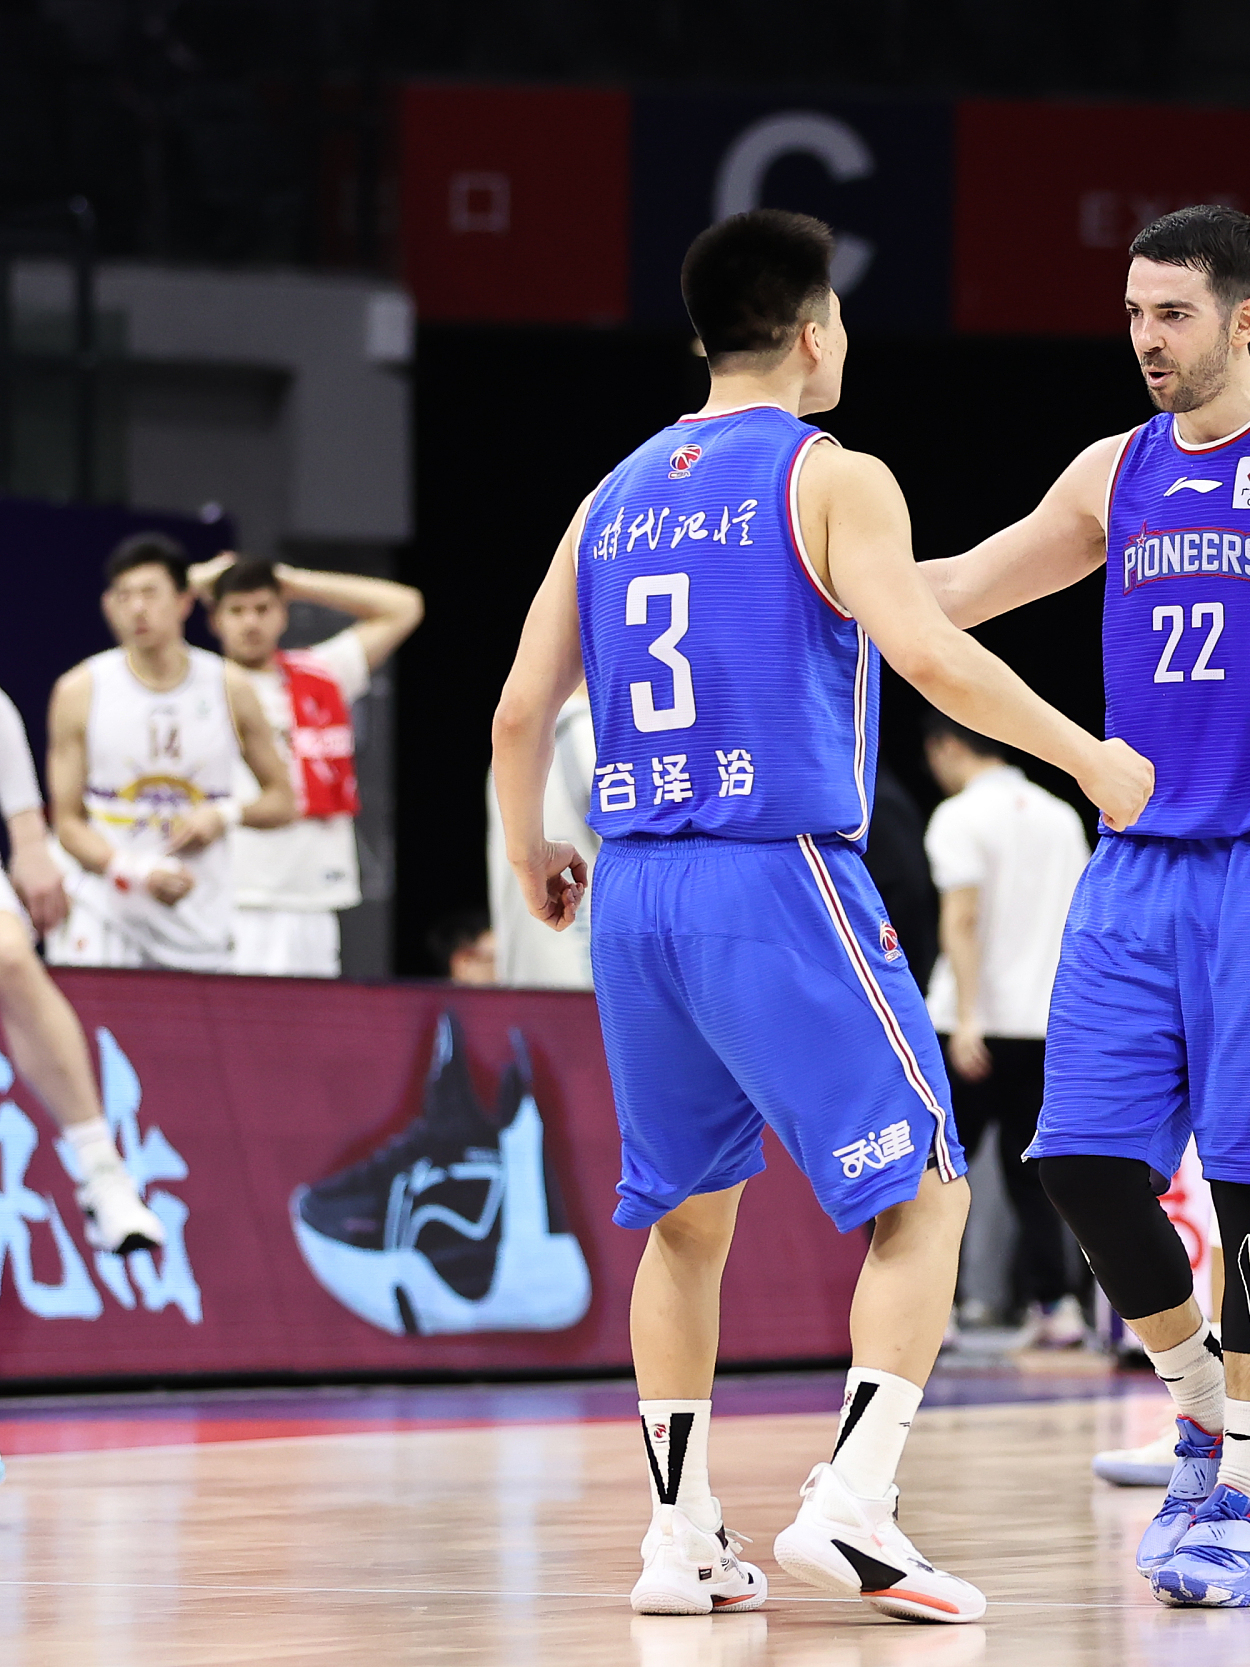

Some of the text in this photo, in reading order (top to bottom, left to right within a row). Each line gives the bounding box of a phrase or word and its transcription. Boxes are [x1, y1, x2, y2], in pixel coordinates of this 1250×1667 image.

[625, 572, 697, 733] 3
[1152, 602, 1225, 683] 22
[150, 723, 181, 760] 14
